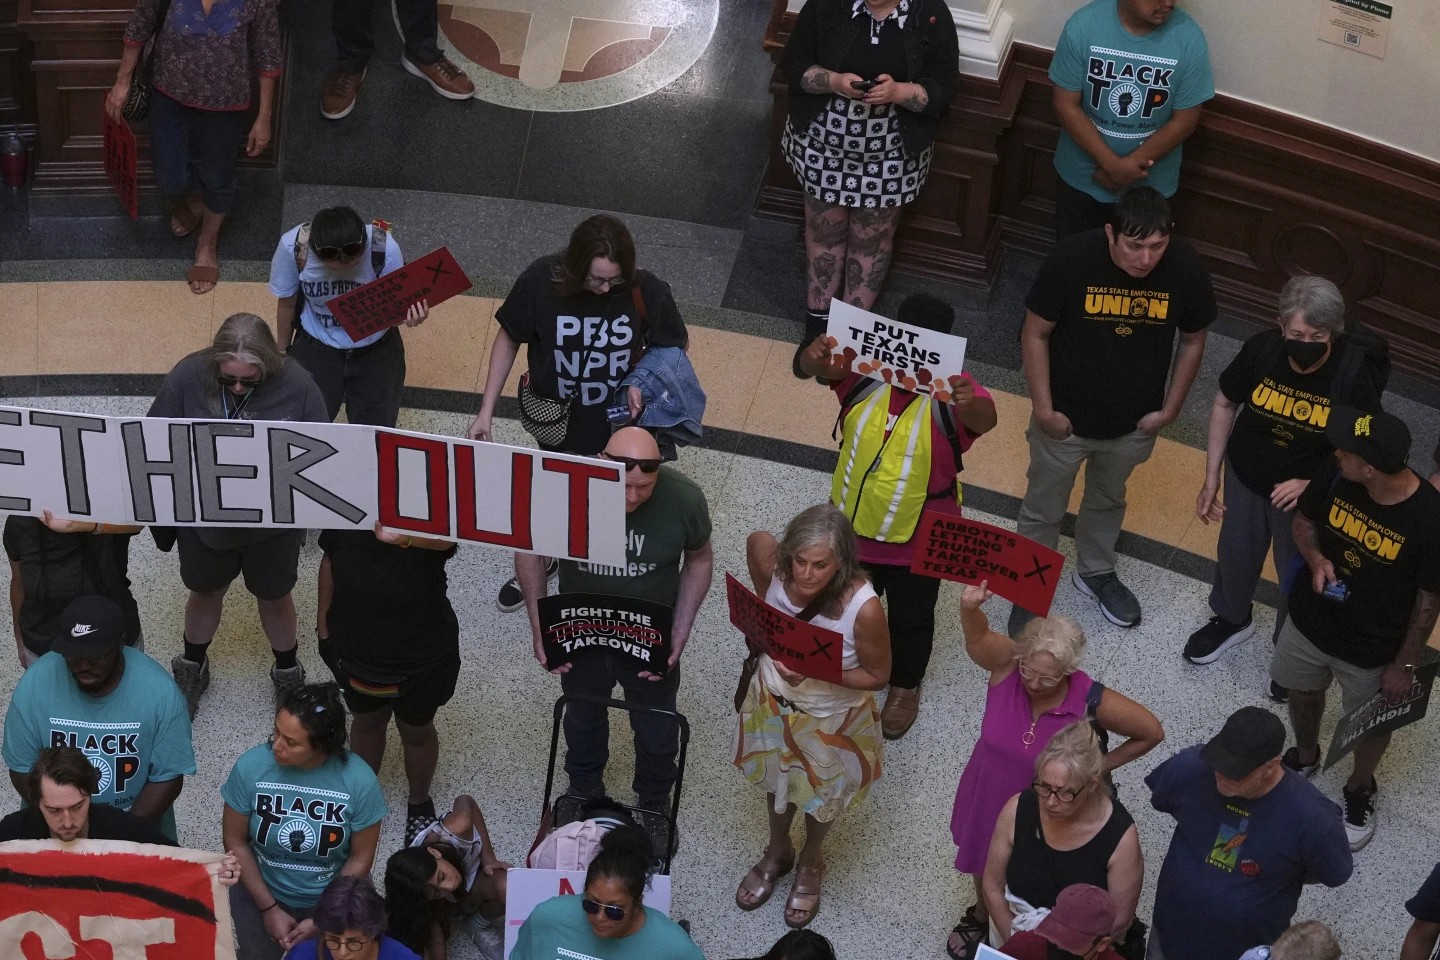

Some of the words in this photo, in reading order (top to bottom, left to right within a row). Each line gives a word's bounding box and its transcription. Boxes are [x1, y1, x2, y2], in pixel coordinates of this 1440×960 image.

[1088, 56, 1174, 87] BLACK
[1084, 294, 1169, 319] UNION
[1086, 286, 1108, 294] TEXAS
[1109, 287, 1129, 296] STATE
[1130, 290, 1170, 300] EMPLOYEES
[556, 314, 633, 348] PBS
[873, 321, 920, 345] PUT
[848, 326, 941, 367] TEXANS
[861, 344, 925, 373] FIRST
[554, 349, 631, 379] NPR
[1251, 382, 1331, 428] UNION
[119, 421, 368, 525] HER
[374, 430, 621, 560] OUT
[1328, 504, 1402, 561] UNION
[1333, 497, 1353, 512] TEXAS
[1353, 508, 1368, 522] STATE
[1367, 519, 1406, 544] EMPLOYEES
[928, 538, 988, 557] TRUMP
[930, 528, 1003, 553] LETTING
[922, 561, 978, 580] TEXAS
[926, 548, 971, 564] TAKE
[974, 558, 1019, 582] OVER
[74, 623, 92, 634] NIKE
[560, 607, 614, 620] FIGHT
[617, 609, 652, 627] THE
[549, 618, 663, 648] TRUMP
[562, 636, 651, 663] TAKEOVER
[1367, 703, 1412, 730] FIGHT
[50, 729, 140, 755] BLACK
[255, 793, 349, 824] BLACK
